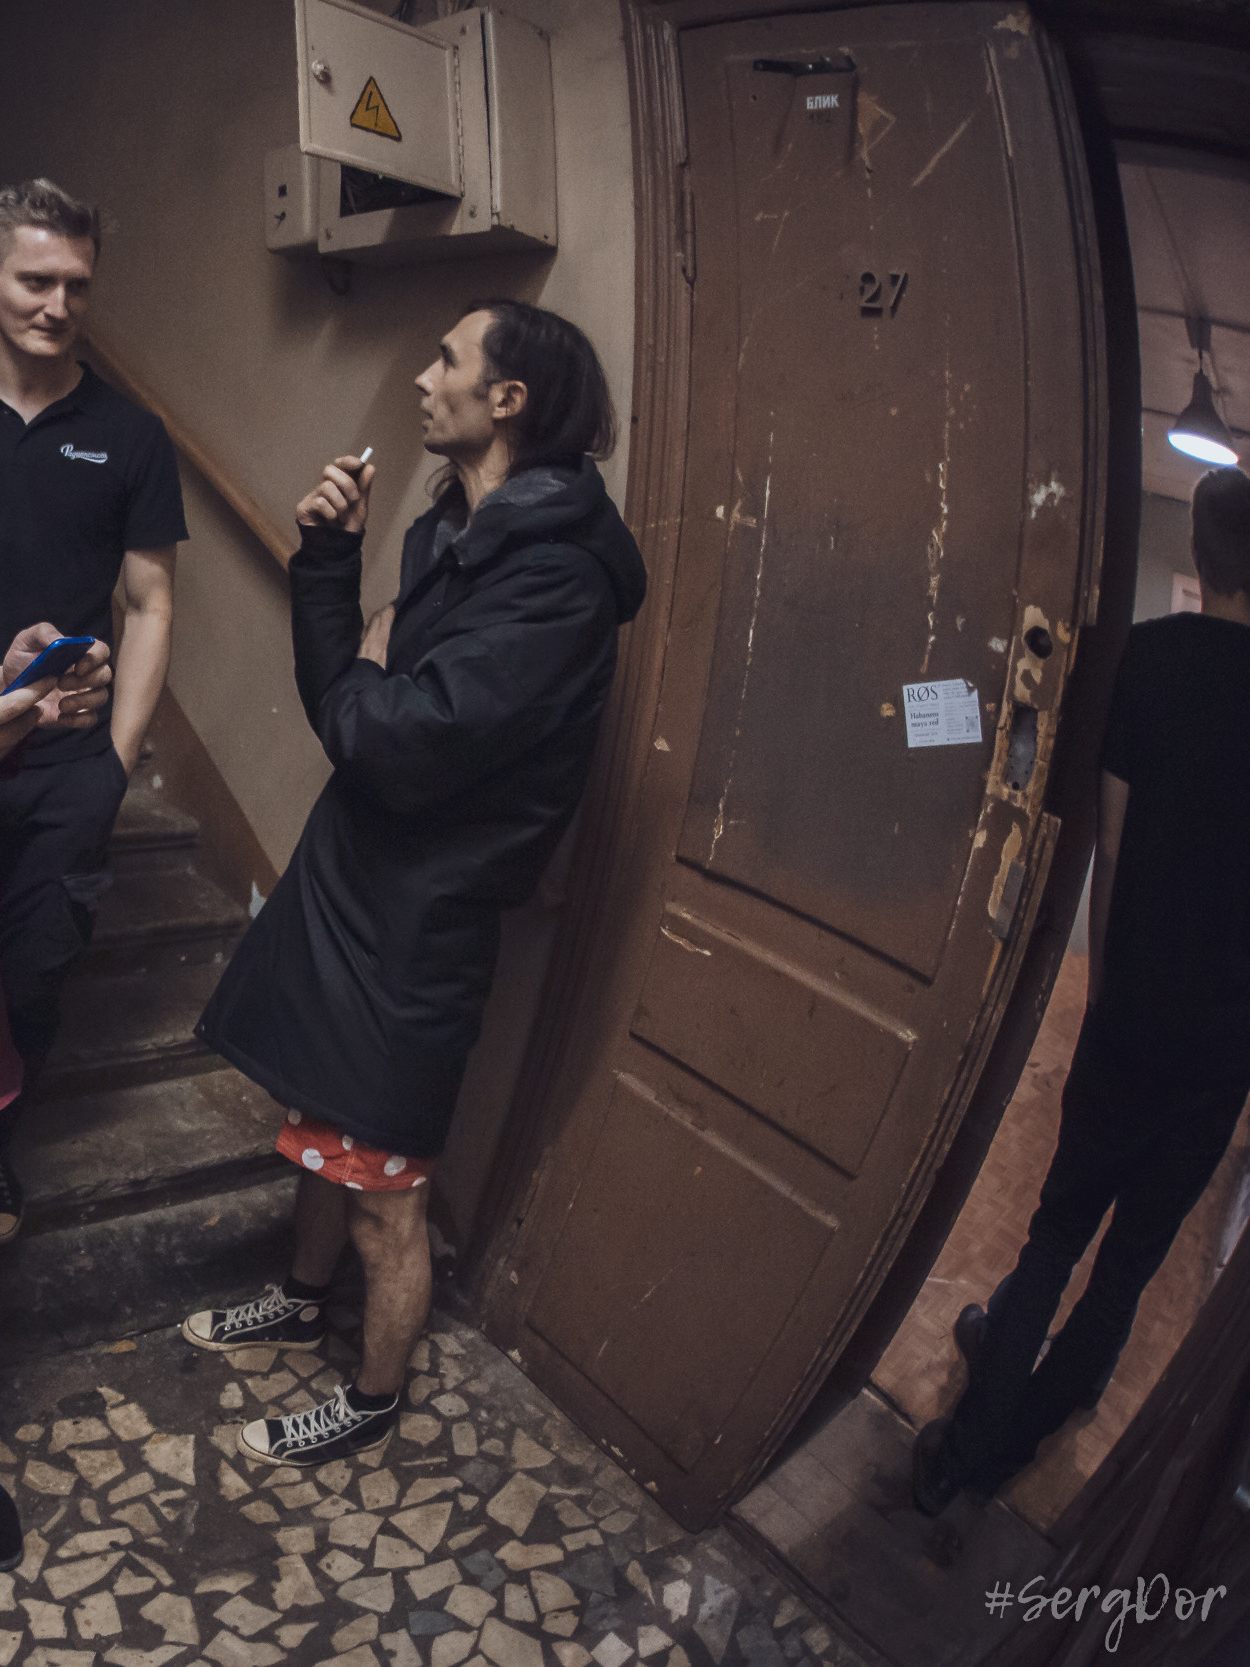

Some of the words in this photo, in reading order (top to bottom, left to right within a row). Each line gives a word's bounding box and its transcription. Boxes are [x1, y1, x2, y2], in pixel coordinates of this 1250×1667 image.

[806, 94, 840, 110] БЛИК
[858, 271, 909, 320] 27
[906, 685, 938, 703] RØS
